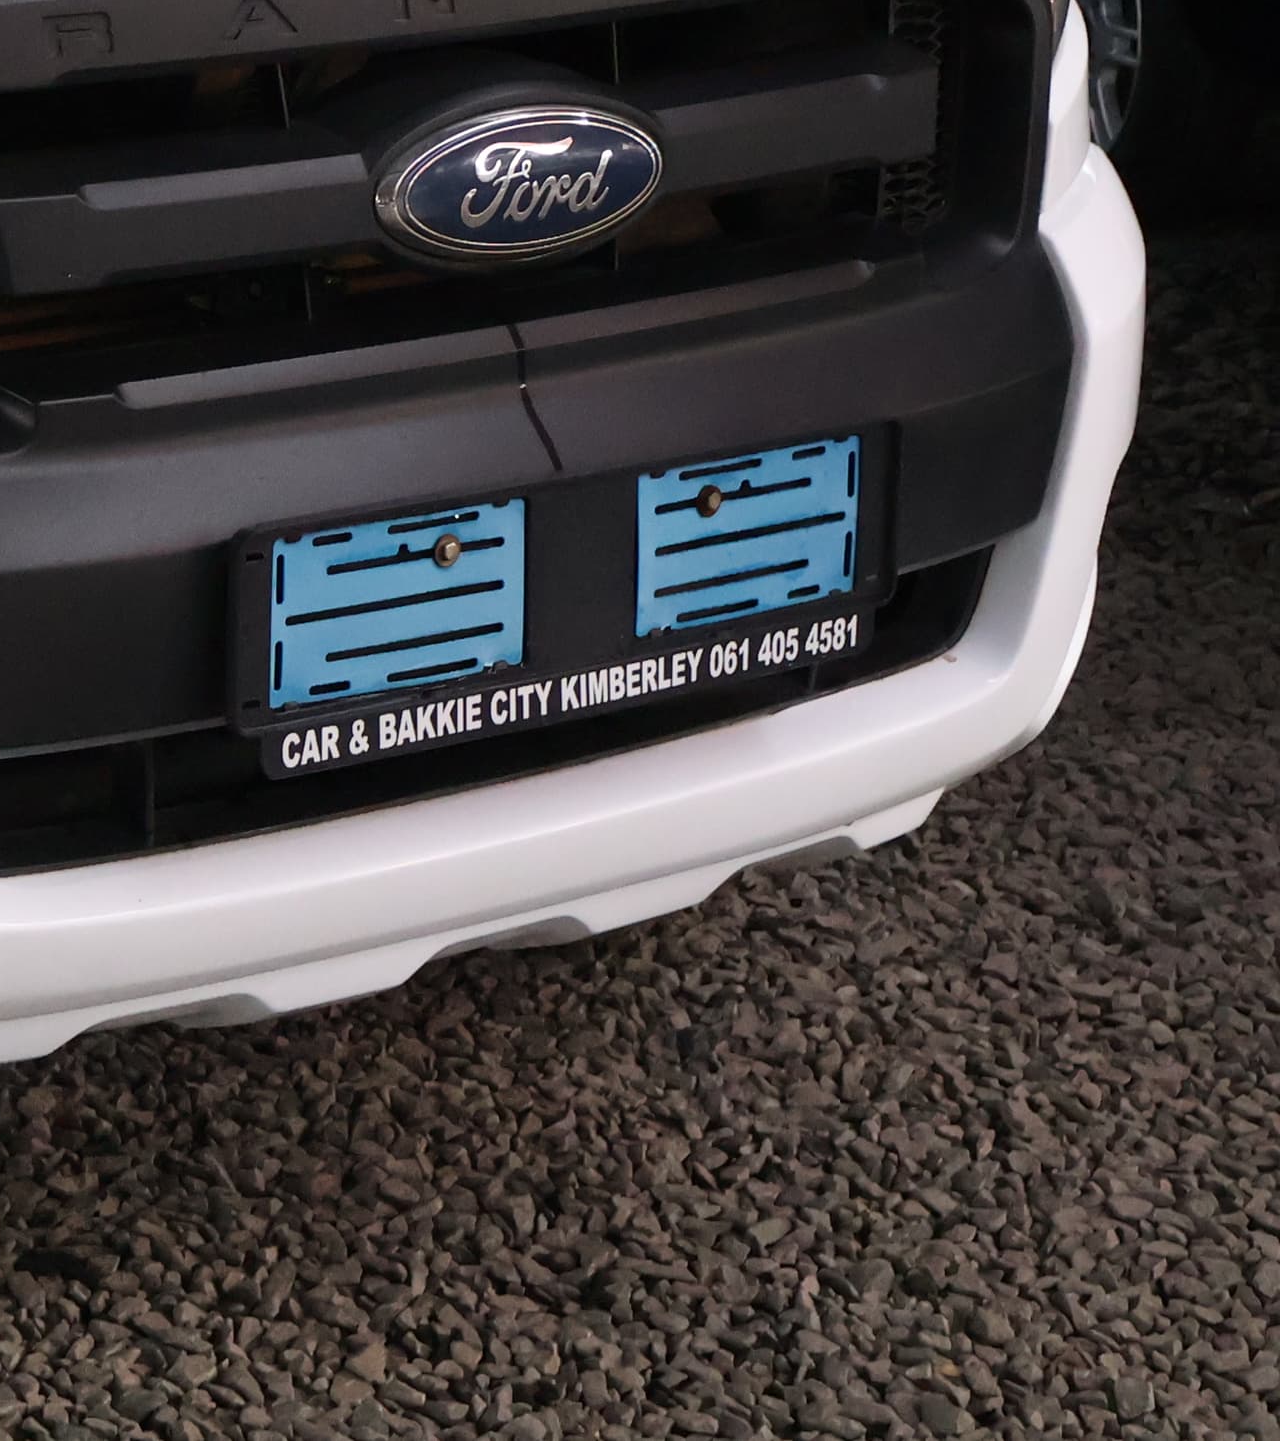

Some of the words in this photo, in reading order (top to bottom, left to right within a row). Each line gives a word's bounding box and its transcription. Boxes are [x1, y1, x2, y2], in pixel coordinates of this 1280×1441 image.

[460, 136, 613, 228] Ford
[281, 724, 340, 769] CAR
[347, 718, 370, 756] &
[378, 692, 483, 750] BAKKIE
[489, 679, 553, 726] CITY
[560, 648, 705, 712] KIMBERLEY
[709, 637, 750, 678] 061
[757, 626, 800, 667] 405
[804, 613, 859, 657] 4581
